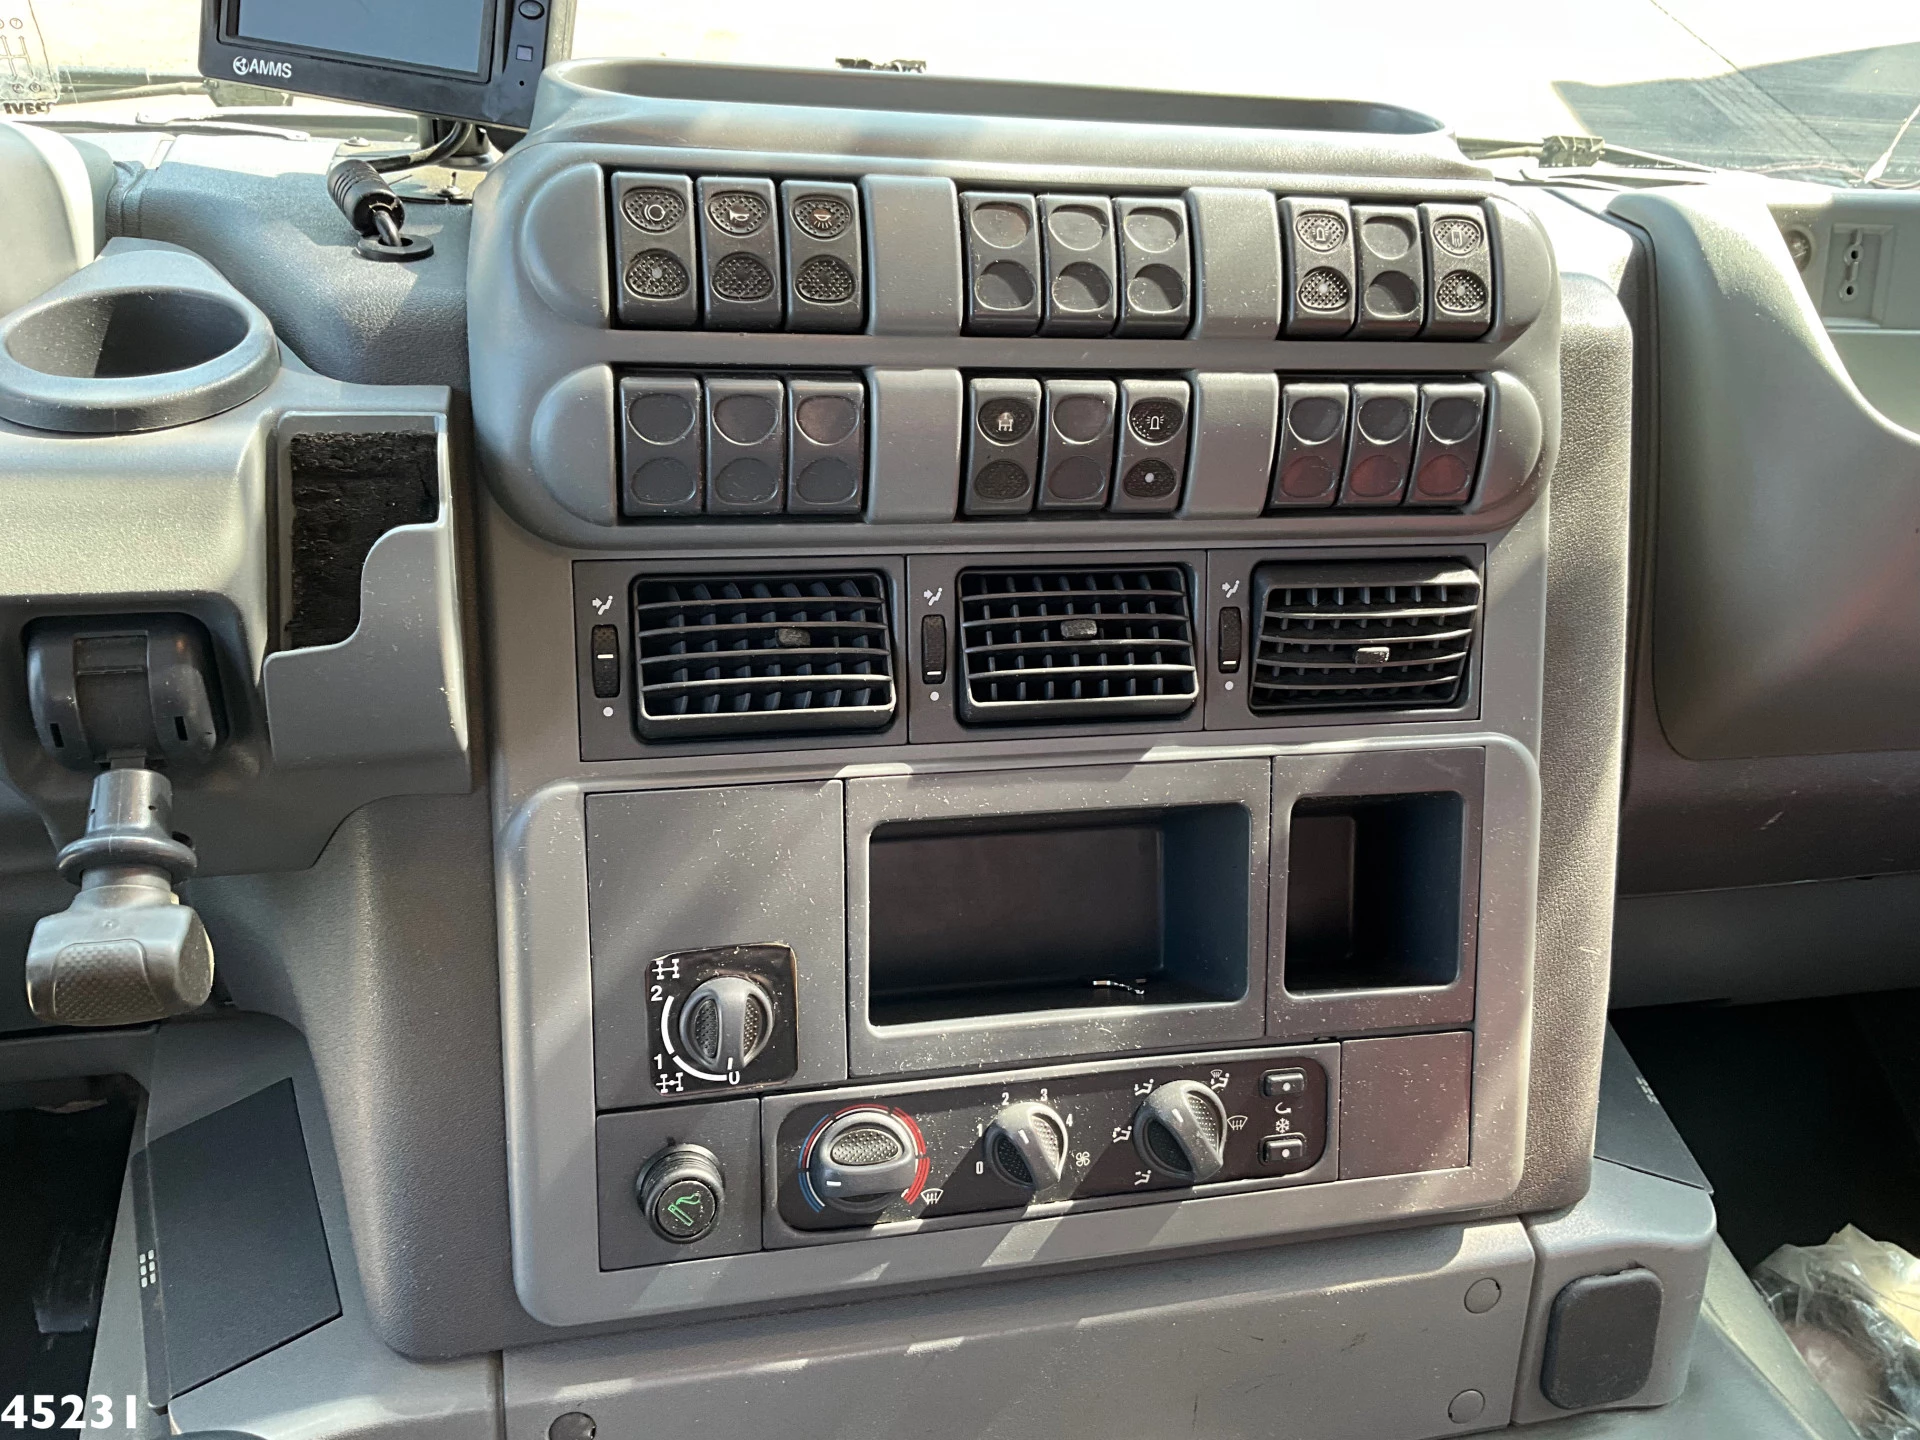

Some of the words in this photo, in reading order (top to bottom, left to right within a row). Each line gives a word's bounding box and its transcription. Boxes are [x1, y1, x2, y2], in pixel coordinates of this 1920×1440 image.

[249, 58, 292, 78] AMMS
[651, 985, 663, 1001] 2
[653, 1053, 662, 1069] 1
[728, 1071, 740, 1085] 0
[1002, 1092, 1009, 1105] 2
[1040, 1088, 1048, 1101] 3
[1066, 1113, 1073, 1127] 4
[976, 1123, 983, 1137] 1
[976, 1161, 984, 1174] 0
